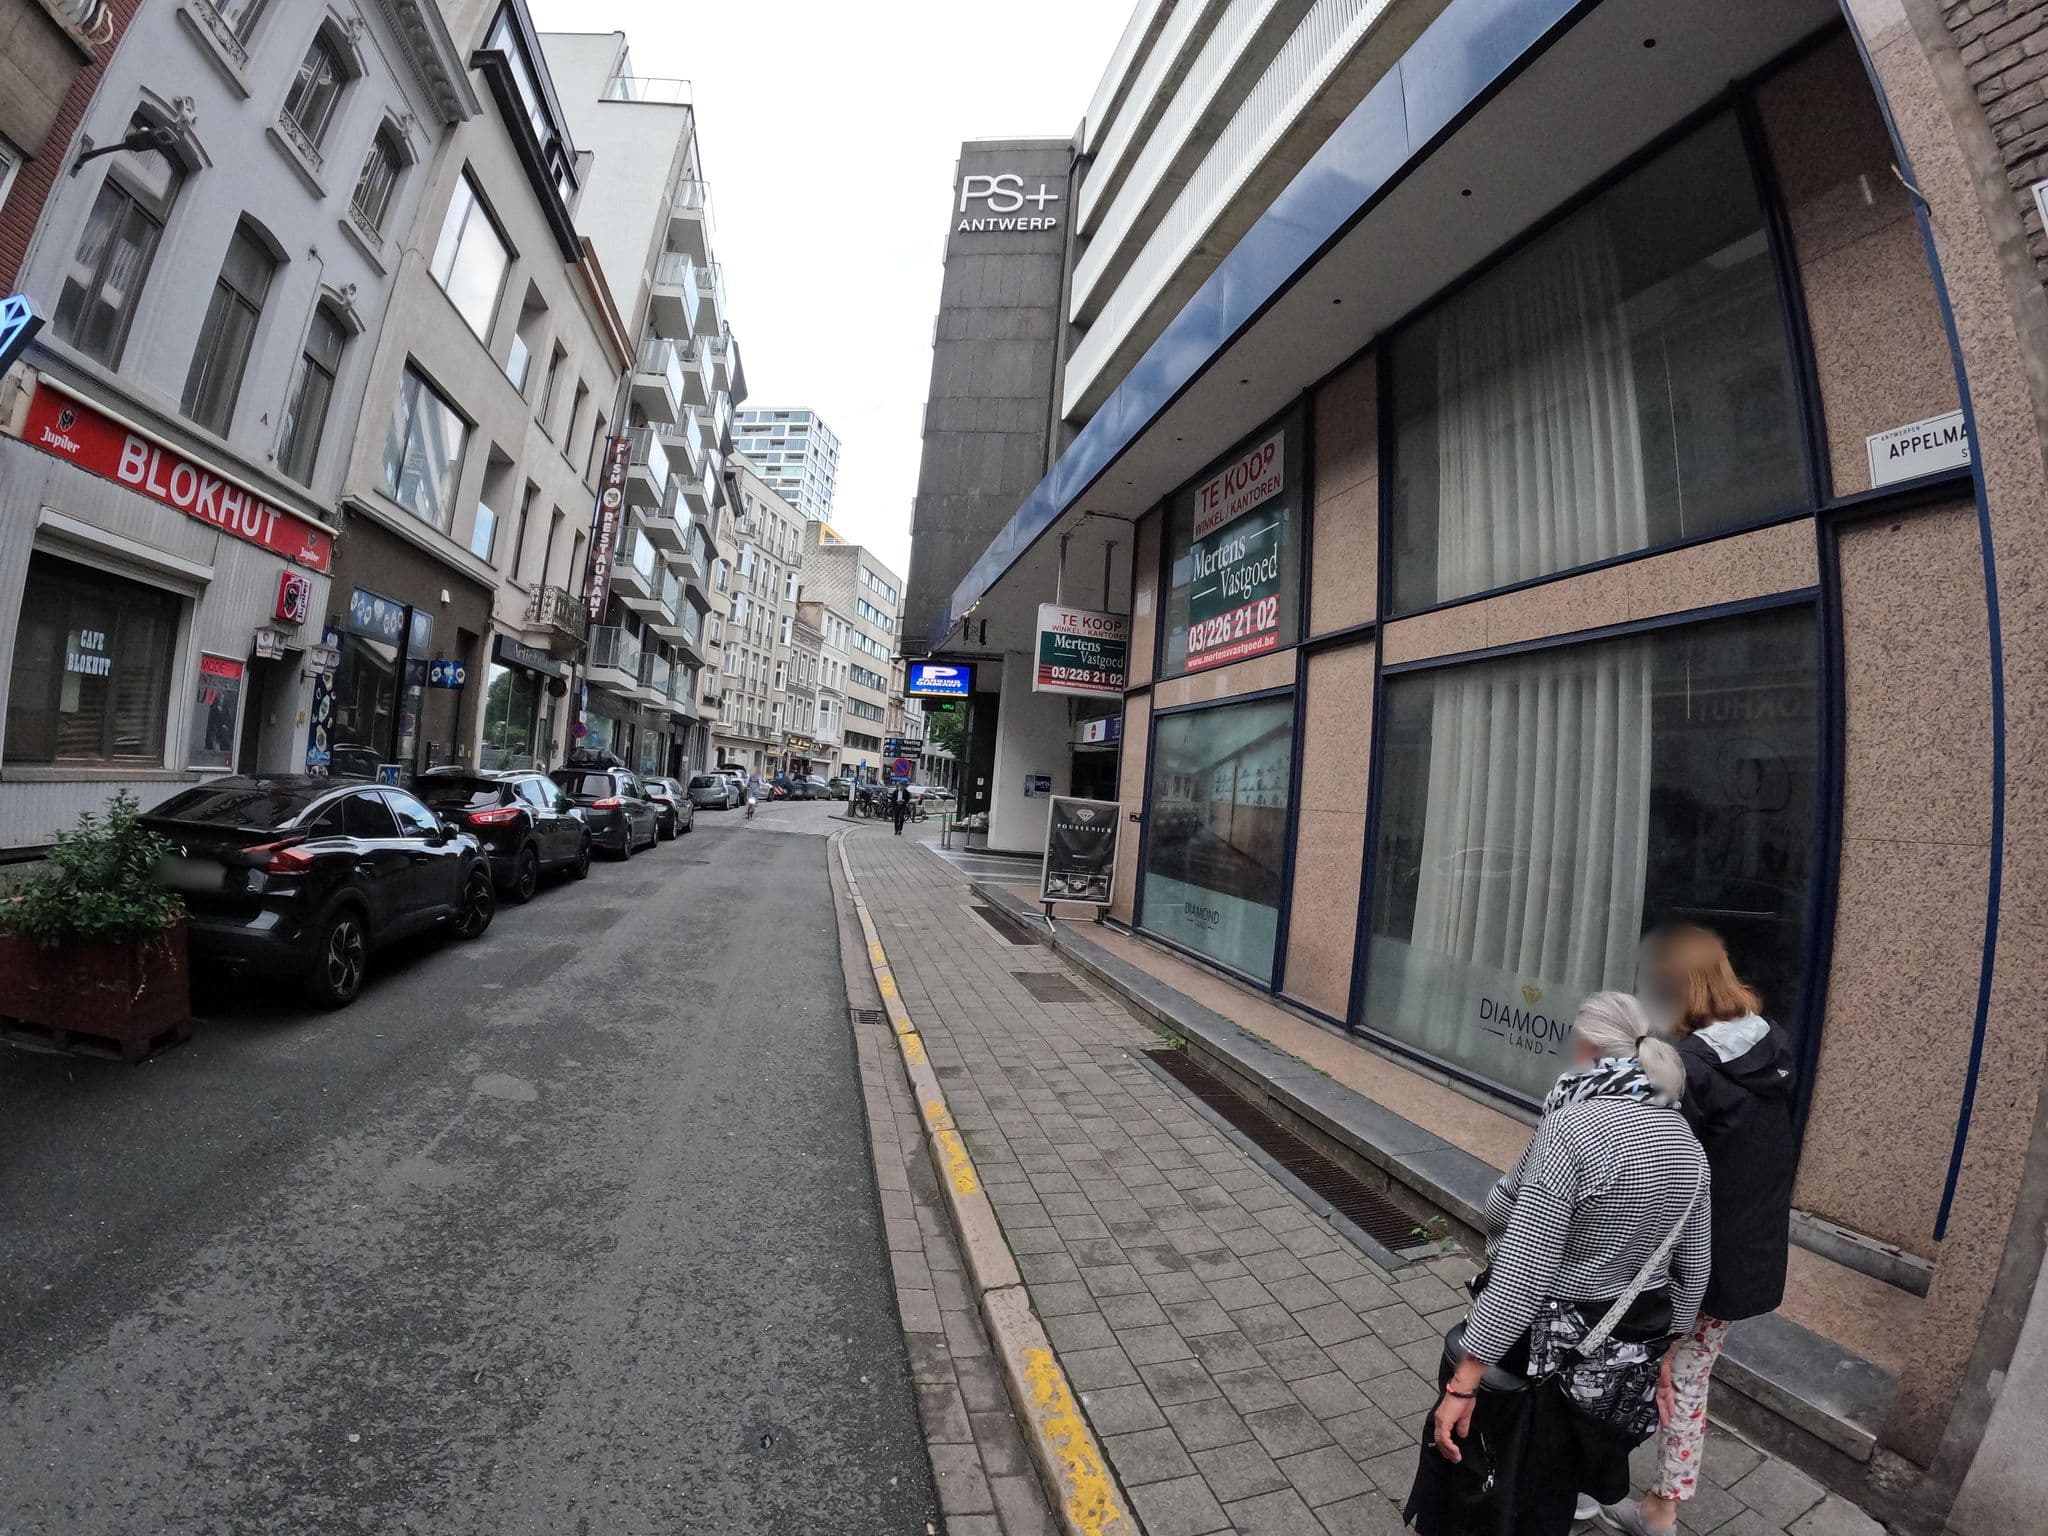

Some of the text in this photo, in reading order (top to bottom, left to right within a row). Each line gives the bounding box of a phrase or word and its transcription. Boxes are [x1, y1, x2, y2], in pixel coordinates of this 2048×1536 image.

[960, 174, 1059, 213] PS+
[958, 217, 1057, 232] ANTWERP
[40, 426, 80, 454] Jupiler
[1881, 425, 1921, 441] ANTWERPEN
[610, 443, 626, 485] FISH
[1201, 442, 1275, 513] TE KOOP
[117, 434, 281, 544] BLOKHUT
[1195, 511, 1224, 536] WINKEL
[1230, 472, 1281, 515] KANTOREN
[589, 511, 615, 618] RESTAURANT
[1193, 535, 1246, 582] Mertens
[1221, 541, 1278, 600] Vastgoed
[1051, 624, 1080, 635] WINKEL
[1088, 630, 1126, 640] KANTORE
[1061, 614, 1122, 633] TE KOOP
[1189, 596, 1277, 653] 03/226 21 02
[1054, 634, 1101, 653] Mertens
[1187, 635, 1275, 667] www.mertensvastgoed.be
[67, 652, 111, 677] BLOKHUT
[1080, 650, 1124, 670] Vastgoed
[1051, 666, 1123, 685] 03/226 21 02
[1184, 902, 1220, 925] DIAMOND
[1509, 1033, 1544, 1055] LAND
